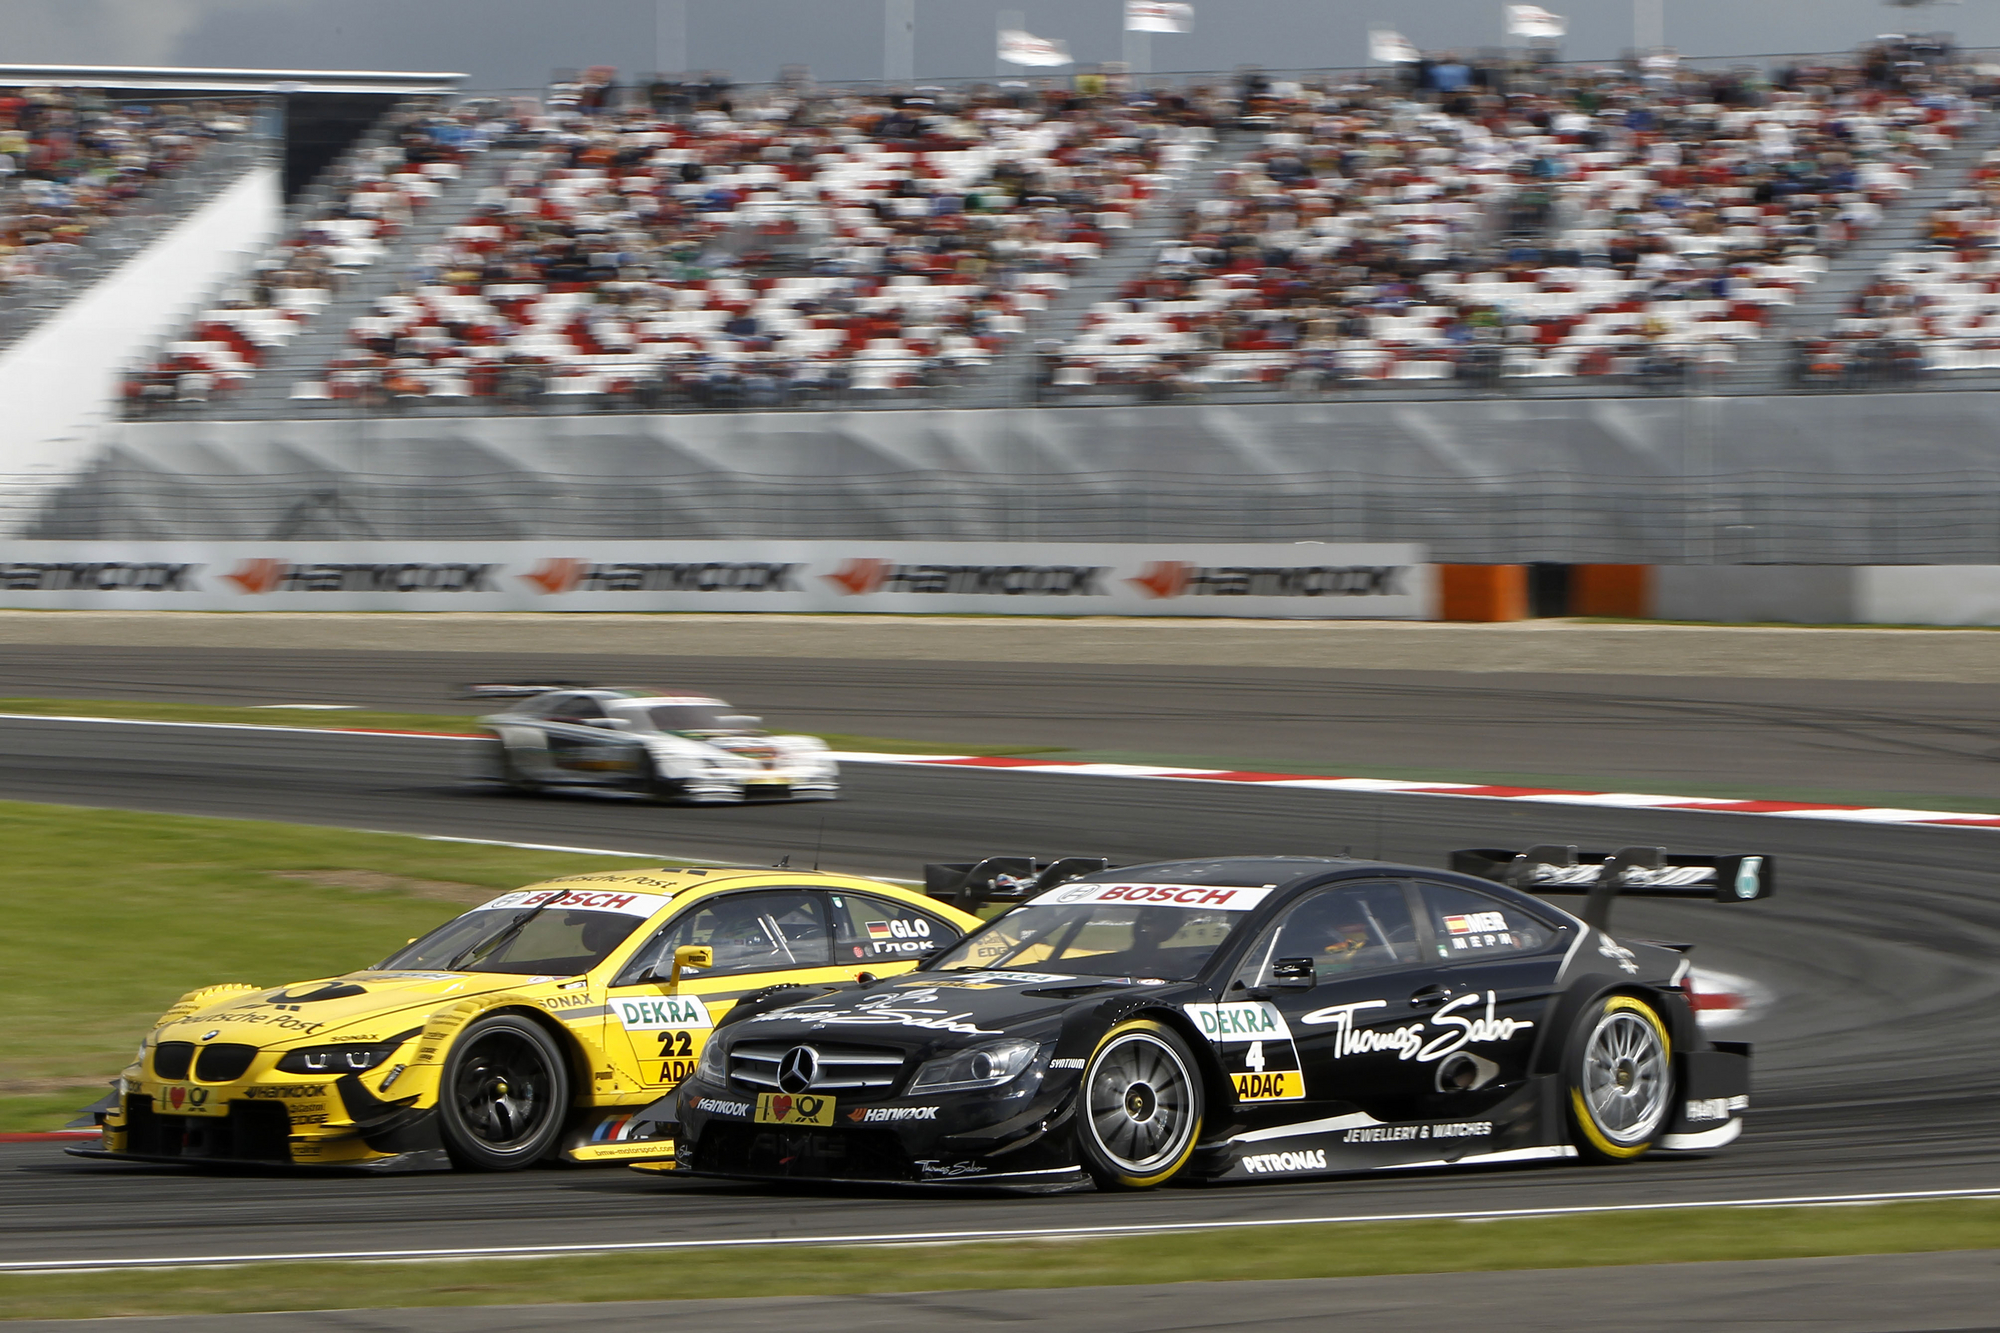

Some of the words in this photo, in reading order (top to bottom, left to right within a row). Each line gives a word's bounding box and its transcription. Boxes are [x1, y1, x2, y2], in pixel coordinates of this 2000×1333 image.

[624, 875, 678, 889] Post
[520, 892, 638, 909] BOSCH
[1097, 885, 1237, 905] BOSCH
[889, 918, 931, 939] GLO
[537, 993, 595, 1009] SONAX
[622, 1000, 699, 1024] DEKRA
[176, 1011, 268, 1026] Deutsche
[265, 1014, 325, 1035] Post
[1199, 1009, 1277, 1034] DEKRA
[1301, 999, 1425, 1060] Thomas
[1416, 989, 1535, 1062] Sabo
[330, 1034, 380, 1042] SONAX
[657, 1031, 693, 1057] 22
[1049, 1058, 1086, 1070] SYNTIUM
[1245, 1041, 1266, 1072] 4
[659, 1060, 696, 1083] ADA
[1238, 1073, 1284, 1098] ADAC
[290, 1113, 330, 1125] EDGE
[1343, 1125, 1419, 1143] JEWELLERY
[1432, 1121, 1493, 1138] WATCHES
[914, 1160, 950, 1175] Thomas
[948, 1160, 988, 1175] Sabo
[1241, 1149, 1327, 1174] PETRONAS
